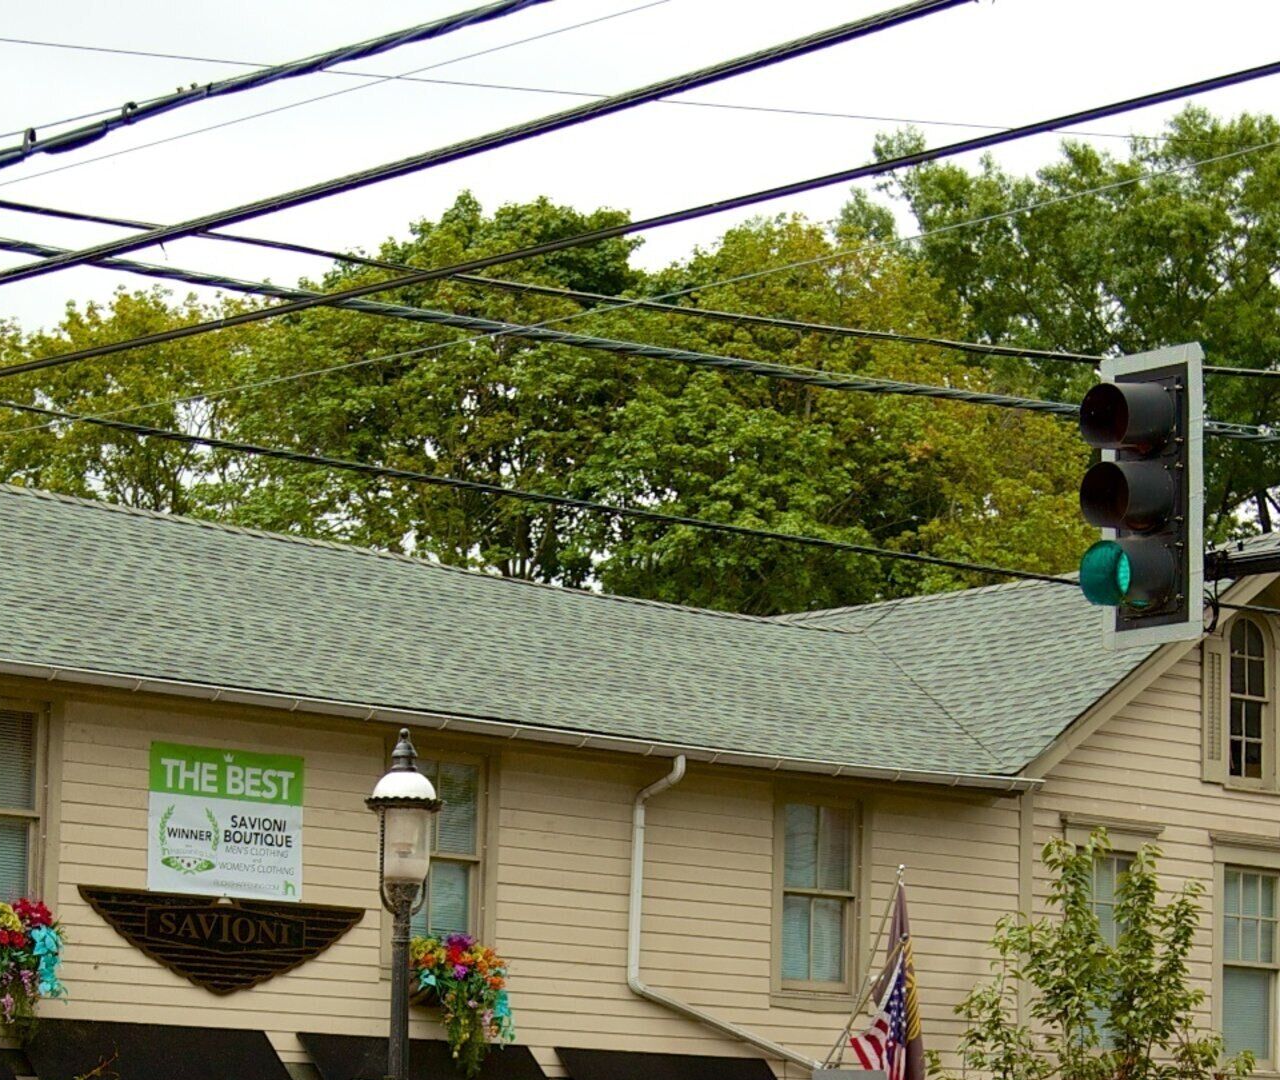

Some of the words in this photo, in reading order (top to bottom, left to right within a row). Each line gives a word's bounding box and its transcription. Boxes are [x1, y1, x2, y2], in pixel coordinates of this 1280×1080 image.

[160, 757, 218, 794] THE
[226, 764, 295, 801] BEST
[230, 814, 287, 833] SAVIONI
[166, 826, 212, 842] WINNER
[223, 829, 293, 848] BOUTIQUE
[250, 846, 289, 859] CLOTHING
[256, 863, 295, 876] CLOTHING
[158, 911, 290, 946] SAVIONI
